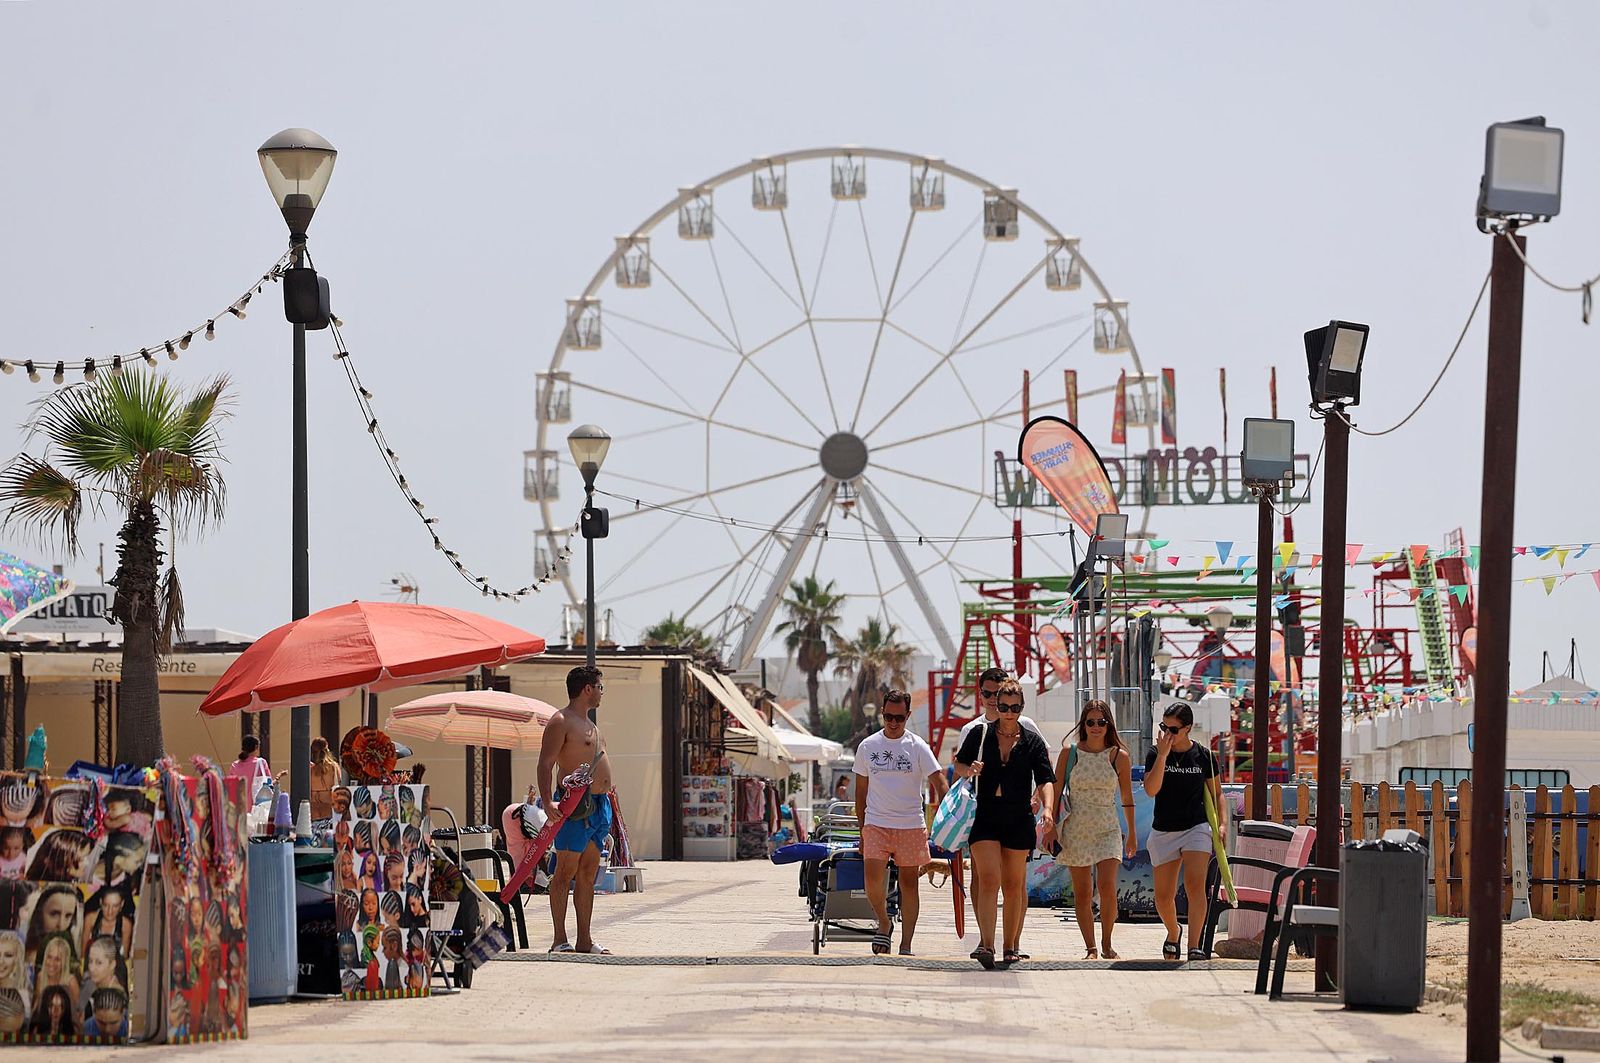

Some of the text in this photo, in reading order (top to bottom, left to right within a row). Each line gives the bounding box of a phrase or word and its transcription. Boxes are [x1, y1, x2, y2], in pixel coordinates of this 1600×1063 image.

[53, 594, 105, 617] PATO
[92, 657, 196, 673] Resante
[1185, 766, 1203, 774] KLEIN
